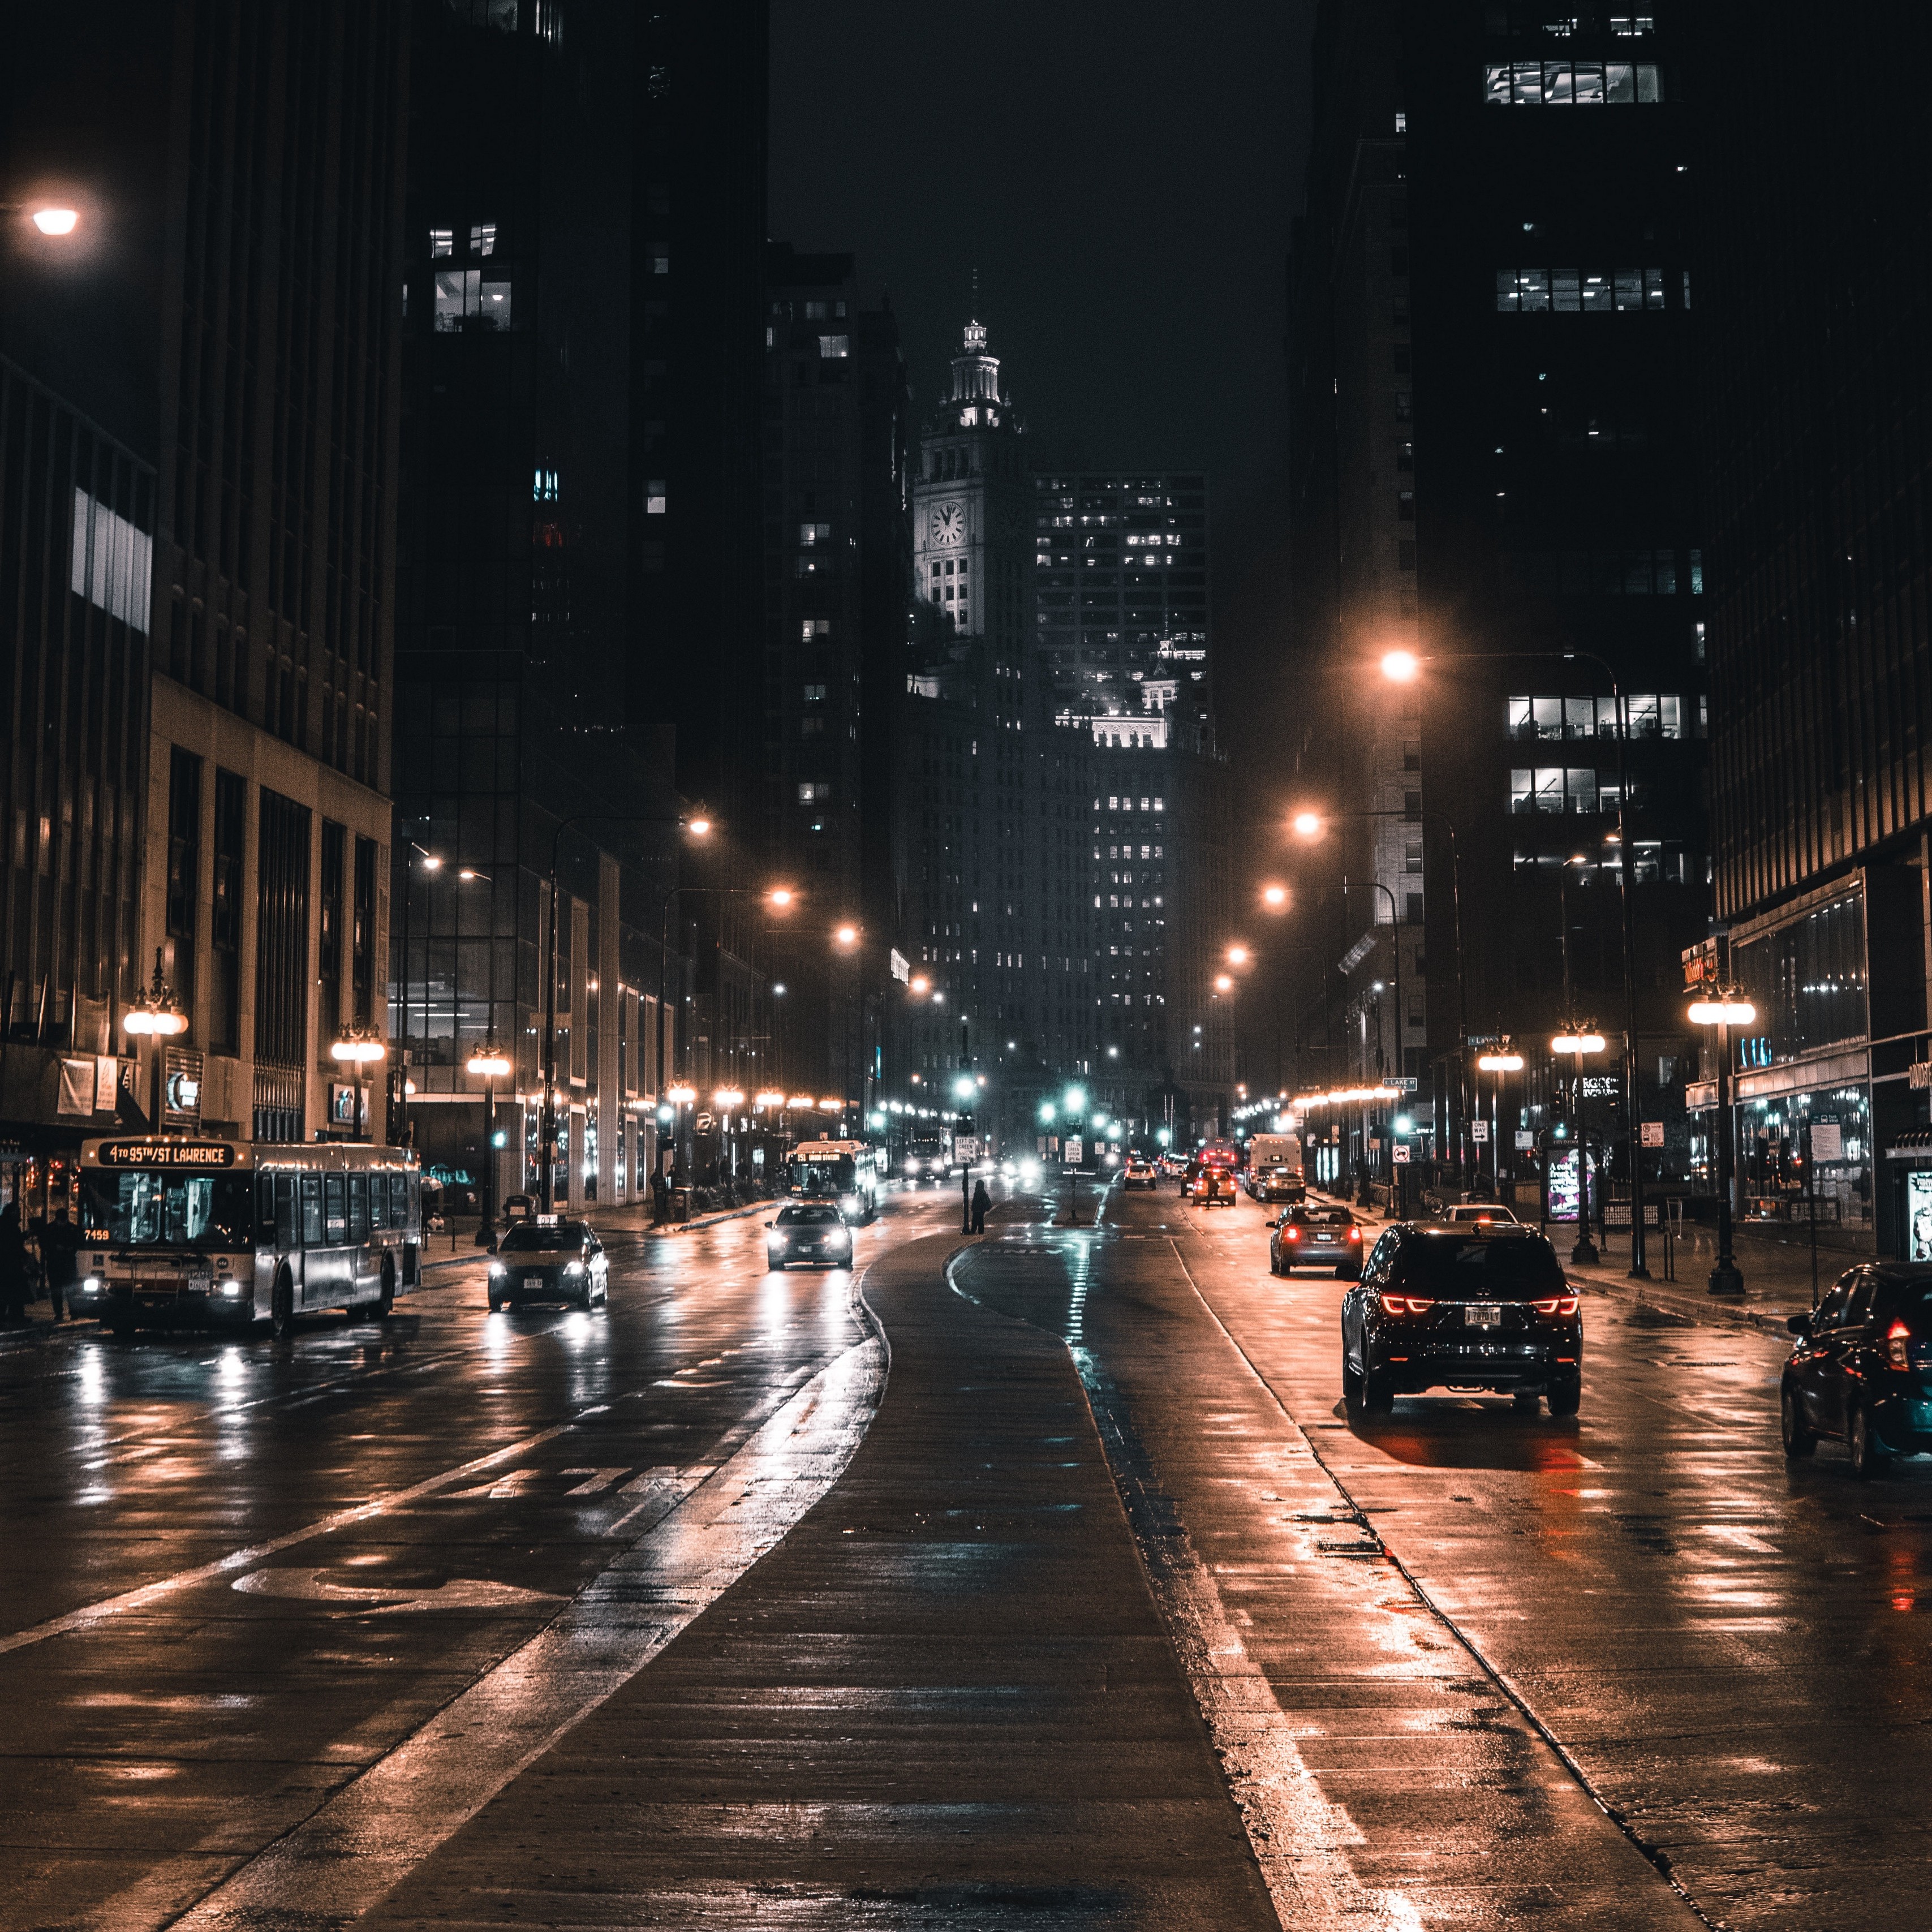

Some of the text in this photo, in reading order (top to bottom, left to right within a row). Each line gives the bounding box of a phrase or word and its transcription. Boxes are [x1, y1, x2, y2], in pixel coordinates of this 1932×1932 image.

[109, 1144, 118, 1163] 4
[118, 1148, 128, 1158] TO
[173, 1147, 225, 1163] LAWRENCE
[797, 1153, 807, 1162] 151
[1556, 1162, 1573, 1171] cold
[84, 1229, 109, 1241] 7459
